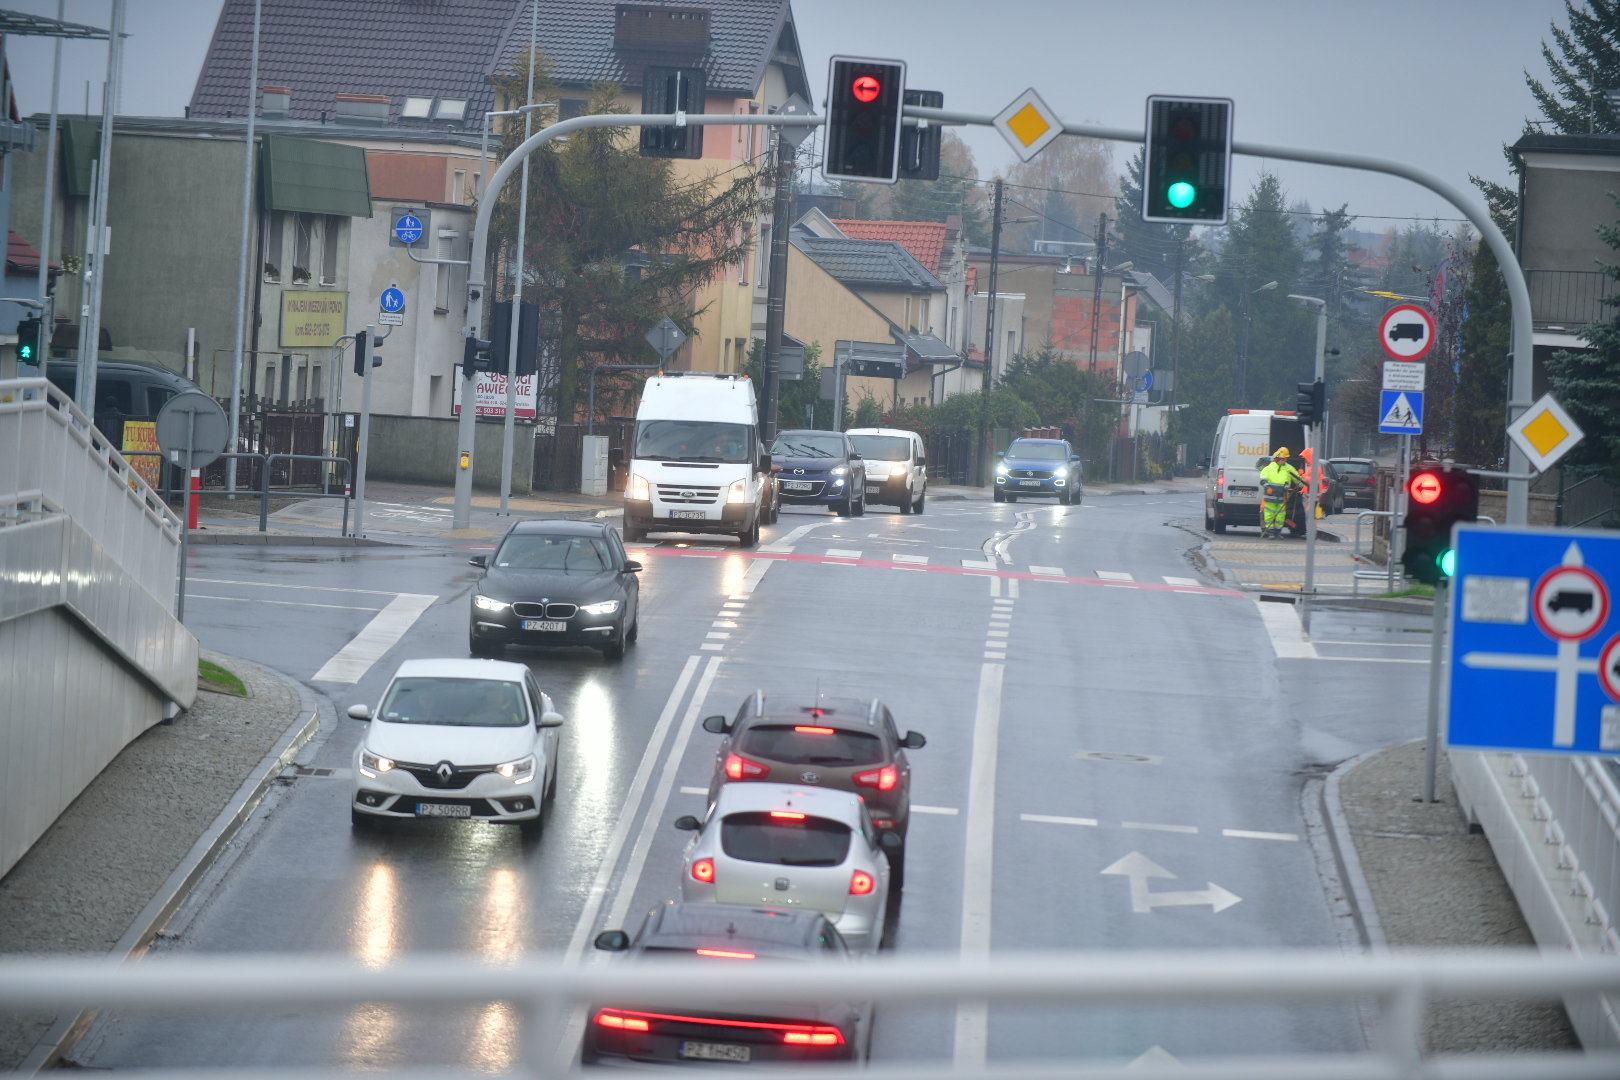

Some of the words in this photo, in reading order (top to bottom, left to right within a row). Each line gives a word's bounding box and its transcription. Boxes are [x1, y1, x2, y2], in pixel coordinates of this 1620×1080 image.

[1237, 442, 1269, 456] budi
[526, 621, 537, 630] PZ
[540, 621, 564, 631] 420TJ
[422, 804, 434, 815] PZ
[438, 805, 469, 816] 509RR
